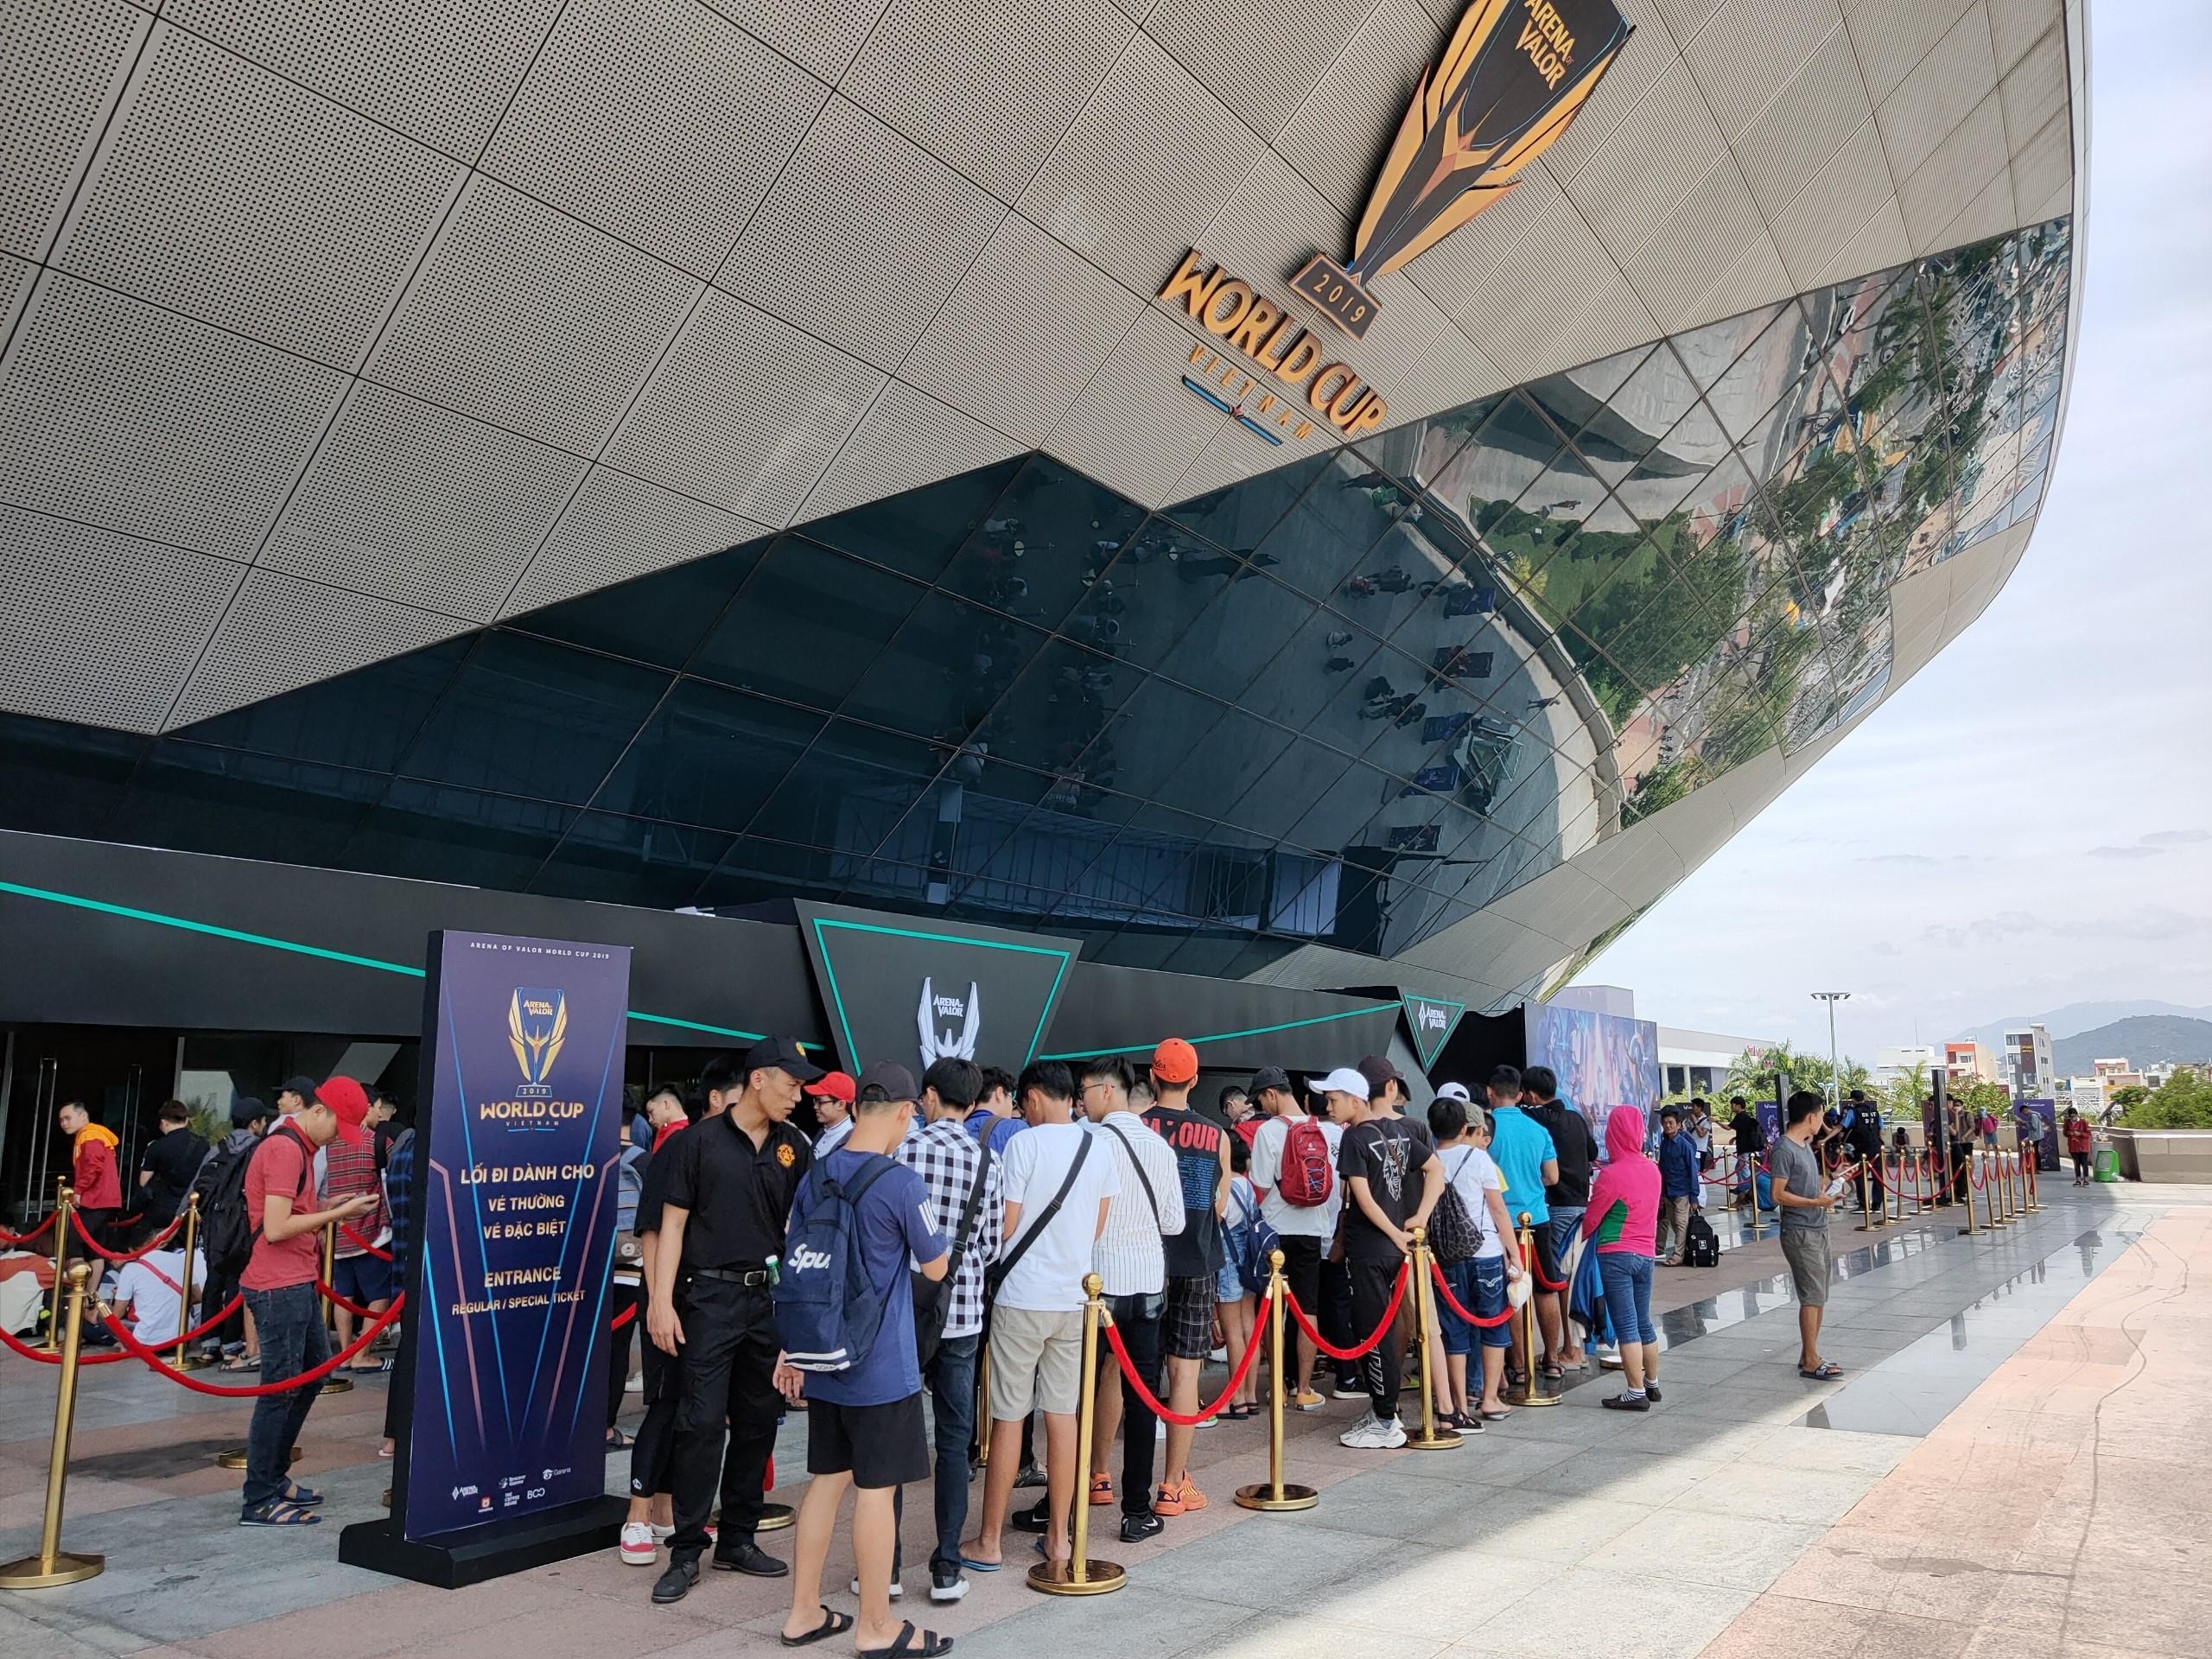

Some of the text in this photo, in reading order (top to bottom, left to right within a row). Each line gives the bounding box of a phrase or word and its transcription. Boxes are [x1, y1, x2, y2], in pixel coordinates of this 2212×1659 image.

[1523, 0, 1575, 62] ARENA
[1515, 19, 1566, 91] VALOR
[1313, 273, 1366, 323] 2019
[1157, 248, 1389, 437] WORLD CUP
[1189, 346, 1313, 440] VIETNAM
[523, 1000, 550, 1008] ARENA
[529, 1007, 553, 1016] VALOR
[933, 994, 960, 1007] ARENA
[938, 1006, 963, 1018] VALOR
[1427, 1005, 1444, 1020] ARENA
[480, 1101, 584, 1121] WORLD CUP
[461, 1161, 595, 1185] LỐI ĐI DÀNH CHO
[487, 1192, 565, 1211] VÉ THƯỜNG
[483, 1218, 567, 1240] VÉ ĐẶC BIỆT
[484, 1266, 562, 1288] ENTRANCE
[452, 1299, 501, 1316] REGULAR
[508, 1293, 550, 1309] SPECIAL
[553, 1289, 586, 1304] TICKET
